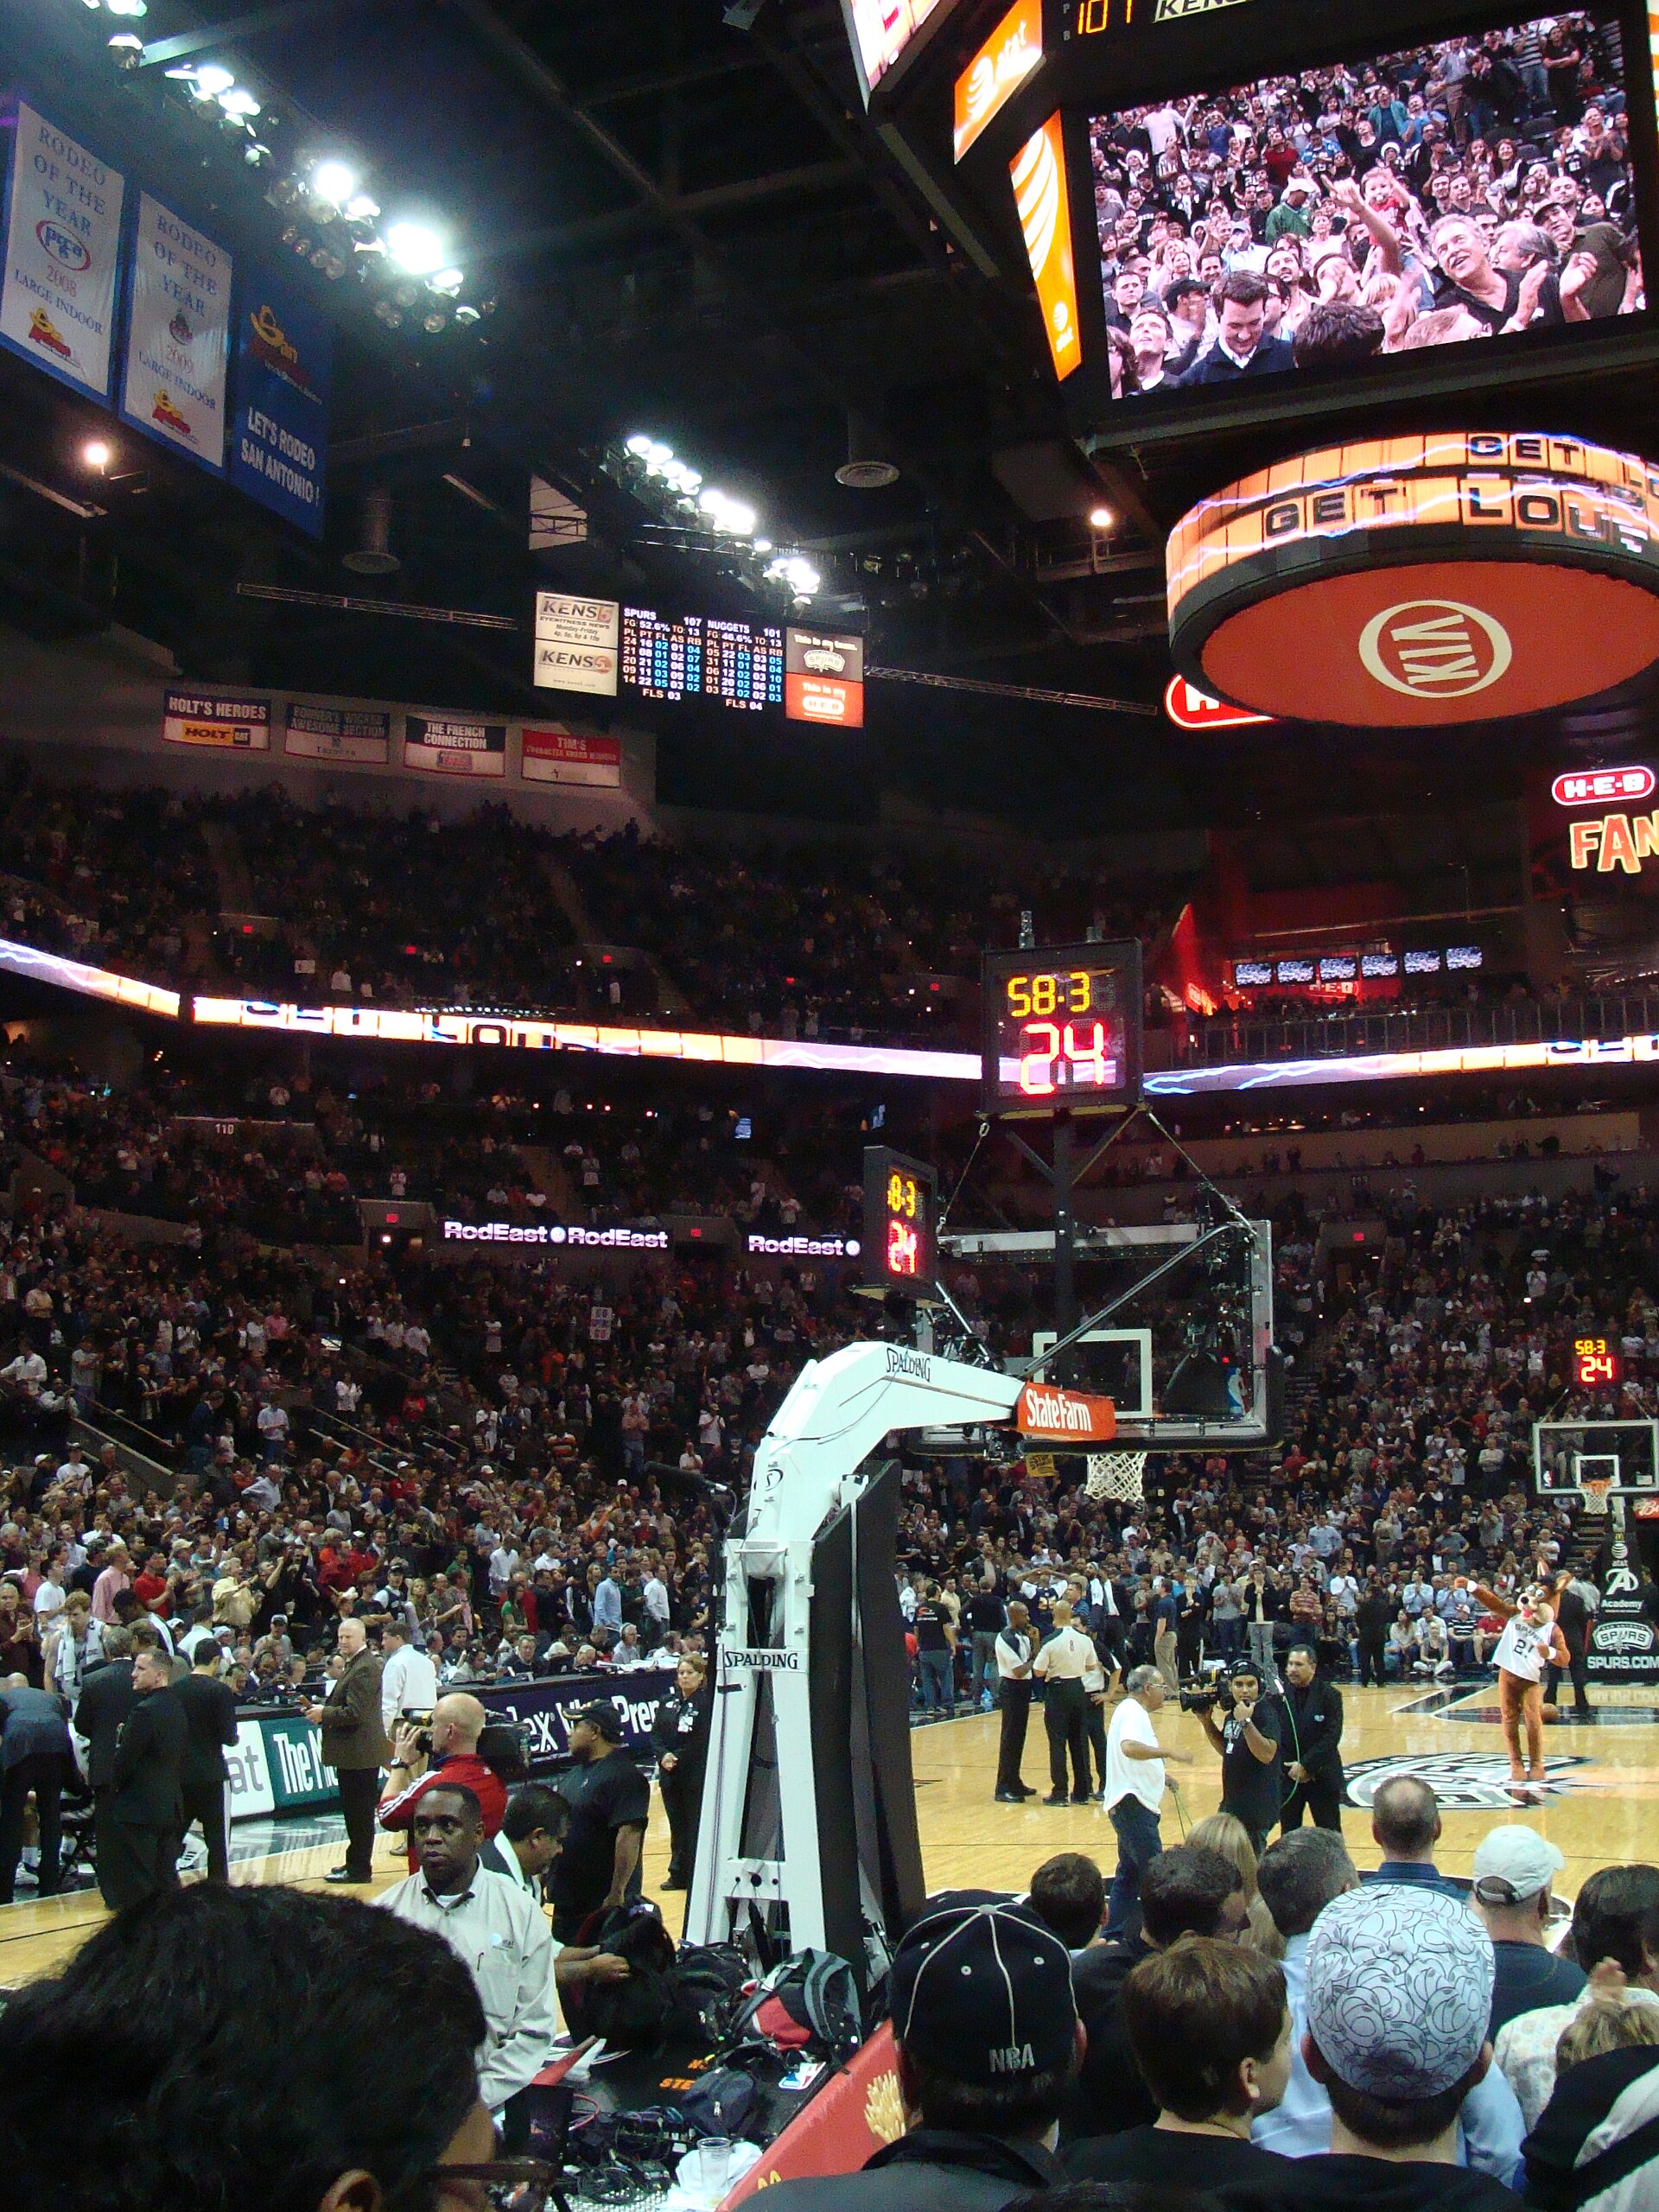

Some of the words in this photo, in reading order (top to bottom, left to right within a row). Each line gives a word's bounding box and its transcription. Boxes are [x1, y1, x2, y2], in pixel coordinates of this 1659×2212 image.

[38, 125, 105, 186] RODEO
[34, 154, 60, 181] OF
[66, 175, 106, 216] THE
[43, 188, 92, 238] YEAR
[156, 213, 216, 268] RODEO
[152, 241, 176, 267] OF
[181, 259, 218, 296] THE
[45, 264, 78, 298] 2008
[15, 268, 53, 305] LARGE
[55, 296, 103, 336] INDOOR
[162, 272, 206, 318] YEAR
[139, 350, 174, 383] LARGE
[174, 374, 216, 410] INDOOR
[247, 406, 278, 448] LET'S
[278, 428, 316, 472] RODEO
[240, 437, 264, 474] SAN
[1468, 435, 1580, 467] GET
[1266, 487, 1399, 537] GET
[542, 600, 598, 620] KENS
[624, 607, 658, 621] SPURS
[683, 616, 702, 627] 107
[540, 616, 588, 627] EYEWITNESS
[588, 621, 611, 631] NEWS
[639, 620, 671, 633] 52.6%
[688, 626, 701, 637] 13
[708, 620, 750, 634] NUGGETS
[763, 626, 781, 639] 101
[623, 637, 638, 646] 24
[640, 639, 654, 648] 16
[655, 640, 669, 651] 02
[670, 643, 683, 652] 01
[687, 645, 701, 655] 04
[624, 627, 637, 638] PL
[639, 630, 654, 639] PT
[656, 632, 668, 642] FL
[671, 634, 685, 644] AS
[687, 637, 702, 646] RB
[721, 632, 753, 645] 46.6%
[769, 639, 783, 648] 13
[793, 634, 812, 645] This
[812, 636, 822, 646] is
[822, 639, 835, 653] my
[623, 646, 636, 656] 21
[655, 650, 668, 659] 01
[670, 652, 684, 662] 02
[687, 654, 701, 664] 07
[706, 648, 721, 658] 05
[722, 650, 736, 660] 22
[737, 652, 751, 662] 03
[753, 654, 767, 664] 03
[768, 656, 783, 666] 05
[707, 639, 721, 649] PL
[722, 642, 736, 651] PT
[738, 644, 751, 653] FL
[753, 645, 767, 655] AS
[768, 648, 784, 658] RB
[1390, 613, 1479, 685] KIA
[541, 651, 596, 669] KENS
[623, 655, 637, 665] 20
[639, 658, 652, 667] 21
[654, 659, 669, 670] 02
[687, 664, 701, 674] 04
[707, 657, 719, 667] 31
[722, 658, 735, 669] 11
[737, 661, 750, 671] 01
[753, 663, 767, 673] 04
[768, 664, 783, 675] 04
[622, 664, 637, 675] 09
[639, 667, 652, 677] 11
[654, 669, 668, 679] 03
[686, 673, 700, 683] 02
[706, 666, 720, 677] 06
[722, 668, 736, 678] 12
[737, 671, 751, 680] 02
[753, 672, 767, 683] 03
[769, 675, 782, 684] 10
[623, 674, 637, 684] 14
[639, 677, 653, 687] 22
[654, 678, 668, 689] 05
[669, 681, 684, 691] 03
[686, 683, 700, 693] 02
[705, 676, 719, 686] 01
[721, 677, 735, 688] 20
[737, 680, 750, 690] 02
[768, 683, 781, 694] 01
[642, 688, 664, 700] FLS
[667, 690, 682, 701] 03
[705, 685, 720, 695] 03
[721, 687, 736, 697] 22
[736, 689, 750, 699] 02
[752, 690, 767, 702] 02
[768, 693, 783, 703] 03
[168, 696, 213, 716] HOLT'S
[215, 702, 268, 721] HEROES
[725, 698, 747, 710] FLS
[749, 701, 764, 712] 04
[184, 727, 232, 740] HOLT
[426, 723, 446, 736] THE
[447, 723, 486, 739] FRENCH
[423, 733, 487, 750] CONNECTION
[556, 736, 588, 752] TIM'S
[1563, 772, 1646, 799] H-E-B
[1020, 1022, 1105, 1095] 24
[215, 1123, 234, 1135] 110
[443, 1221, 549, 1243] RodEast
[568, 1227, 669, 1249] RodEast
[748, 1235, 844, 1255] RodEast
[886, 1347, 931, 1382] SPALDING
[1580, 1356, 1612, 1382] 24
[1600, 1599, 1645, 1610] Academy
[1600, 1629, 1647, 1643] SPURS
[725, 1651, 798, 1669] SPALDING
[1587, 1655, 1659, 1669] SPURS.COM
[273, 1731, 314, 1795] The
[989, 2043, 1035, 2073] NBA
